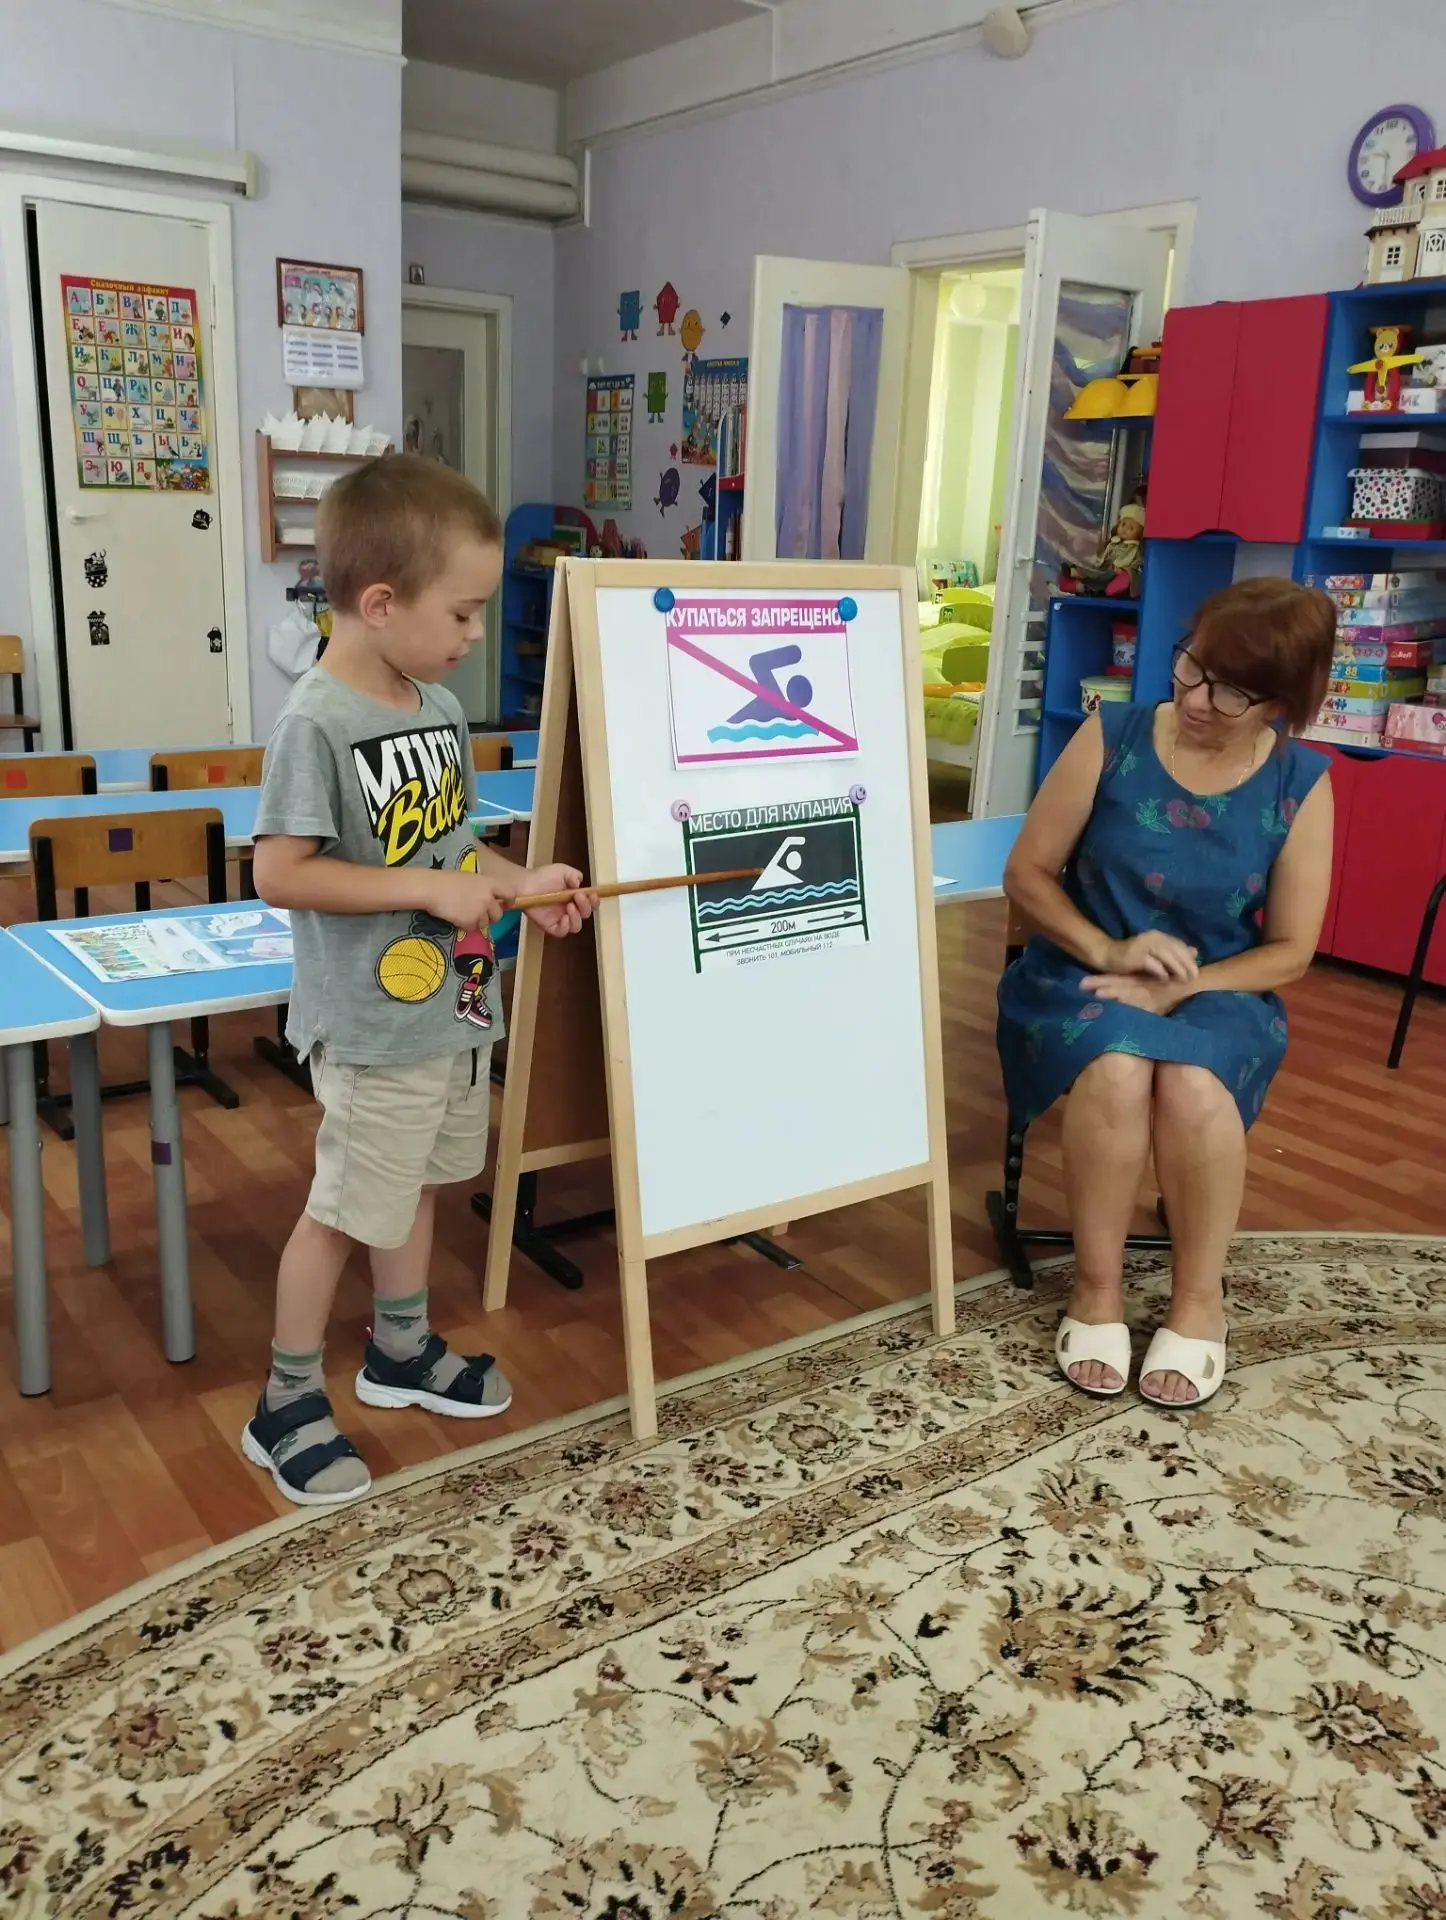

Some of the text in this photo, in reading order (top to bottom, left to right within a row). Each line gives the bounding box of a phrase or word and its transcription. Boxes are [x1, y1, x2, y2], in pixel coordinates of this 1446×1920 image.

[96, 293, 104, 306] Б
[123, 296, 131, 308] В
[146, 299, 154, 311] Г
[125, 323, 138, 335] Ж
[130, 380, 137, 390] Р
[154, 382, 163, 392] С
[178, 383, 186, 393] Т
[110, 460, 122, 472] Ю
[136, 462, 145, 473] Я
[666, 607, 846, 630] КУПАТЬСЯ ЗАПРЕЩЕНО
[688, 797, 854, 834] МЕСТО ДЛЯ КУПАНИЯ
[771, 920, 796, 934] 200м
[726, 931, 840, 957] ПРИ НЕСЧАСТНЫХ СЛУЧАЯХ НА ВОДЕ
[736, 954, 766, 966] ЗВОНИТЬ
[780, 942, 822, 957] МОБИЛЬНЫЙ
